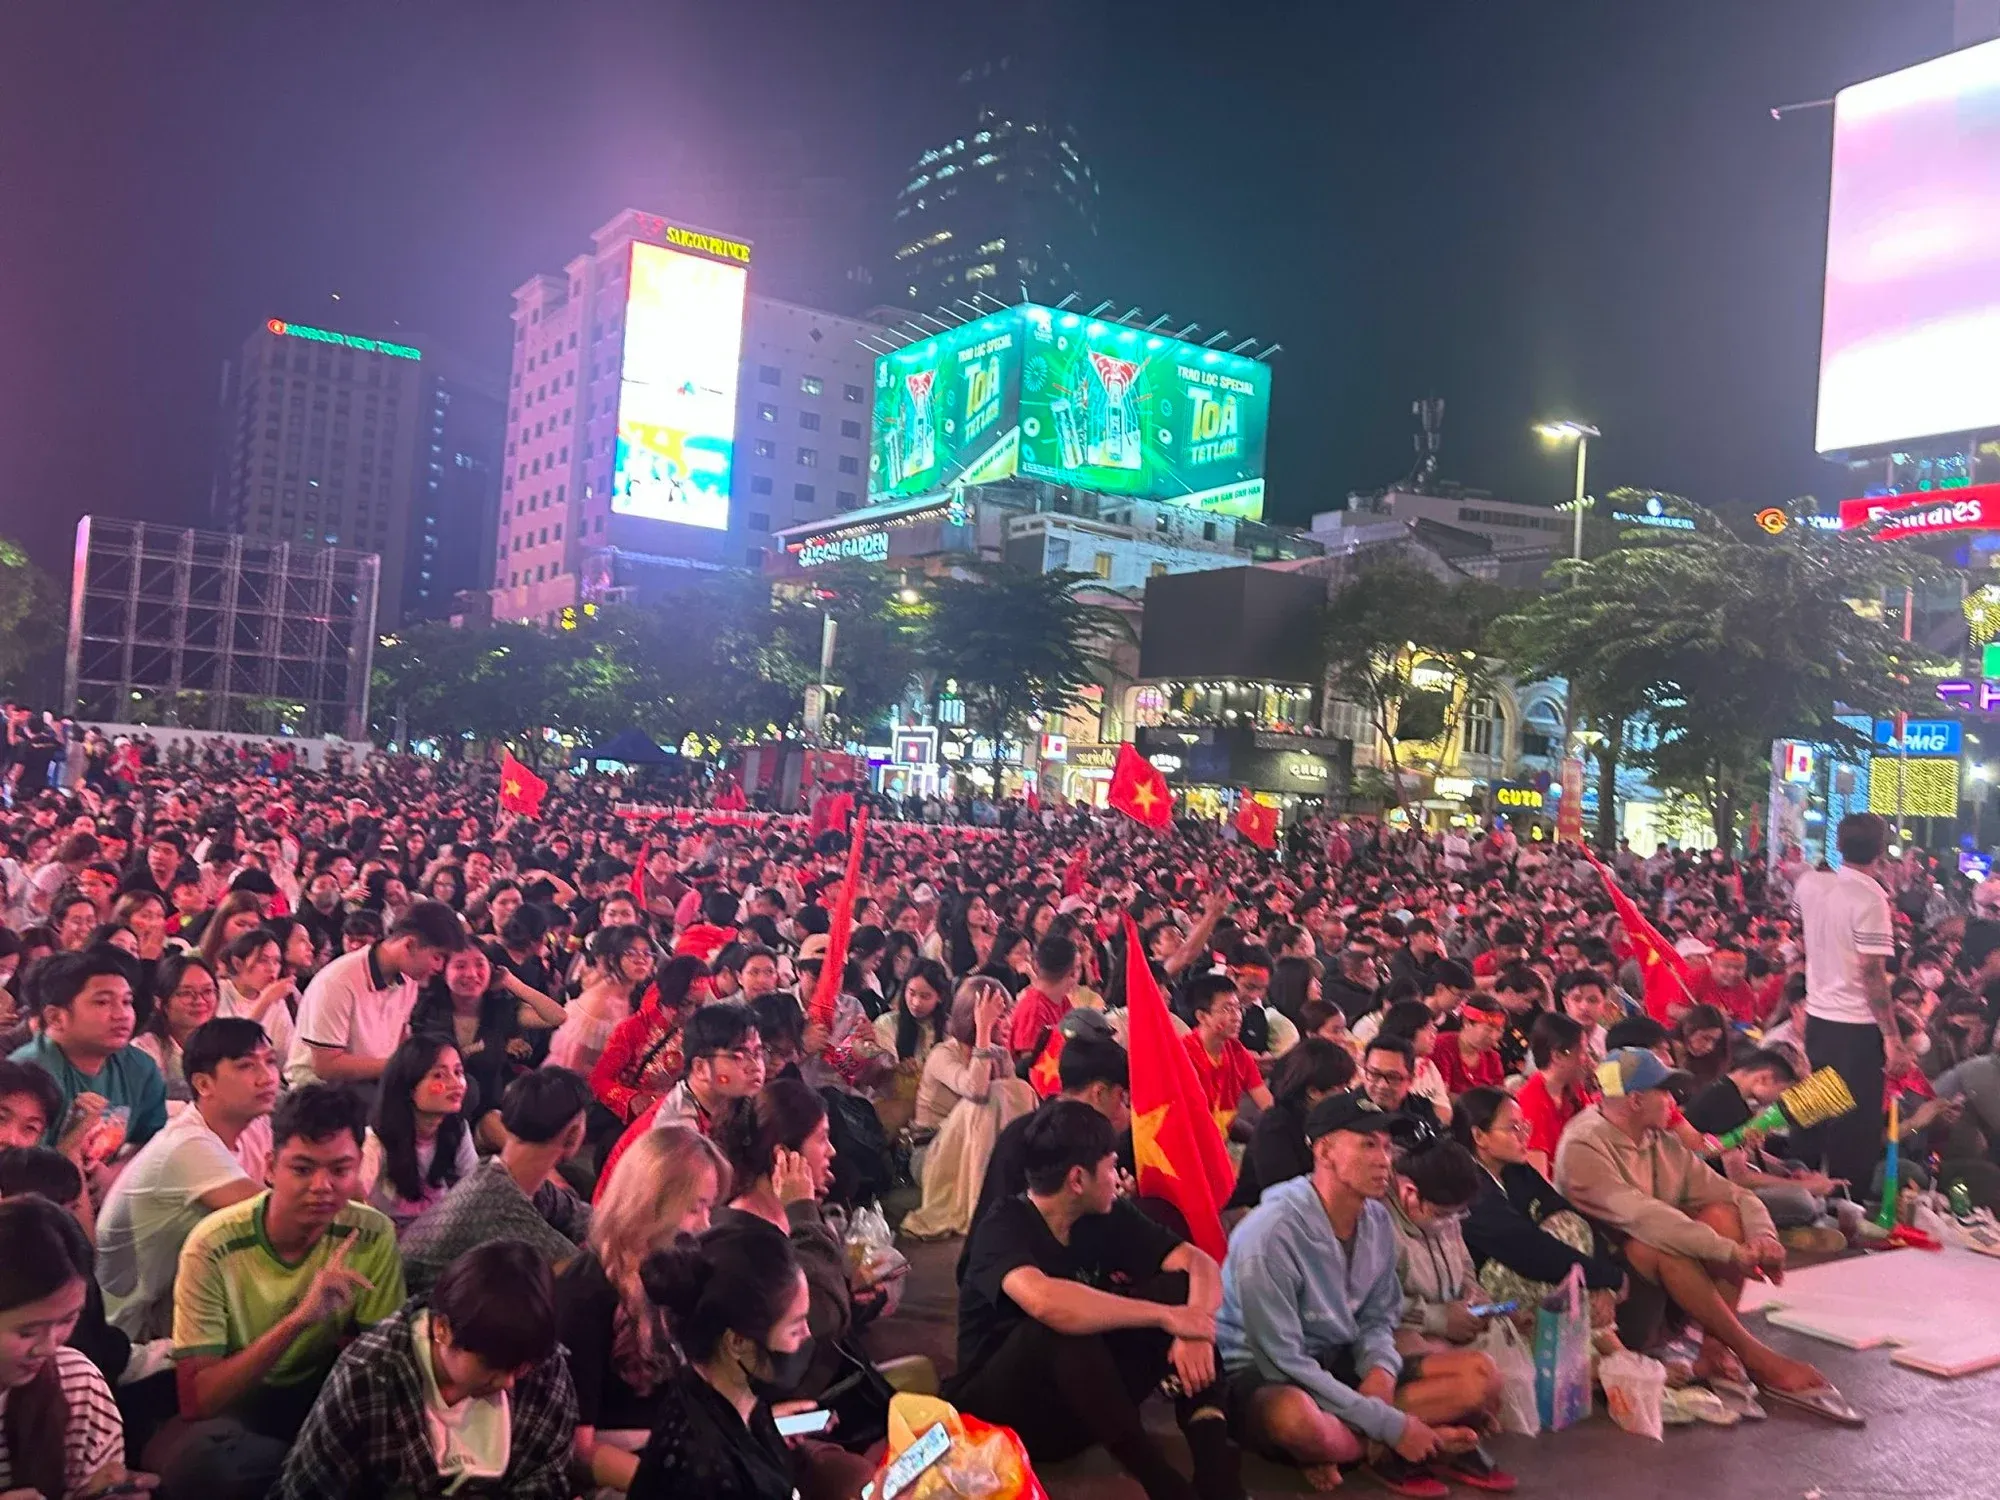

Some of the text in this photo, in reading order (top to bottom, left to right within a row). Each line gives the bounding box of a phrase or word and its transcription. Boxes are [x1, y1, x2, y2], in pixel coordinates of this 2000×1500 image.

[666, 226, 751, 262] SAIGON PRINCE
[841, 532, 889, 557] GARDEN
[1497, 787, 1543, 808] GUTA
